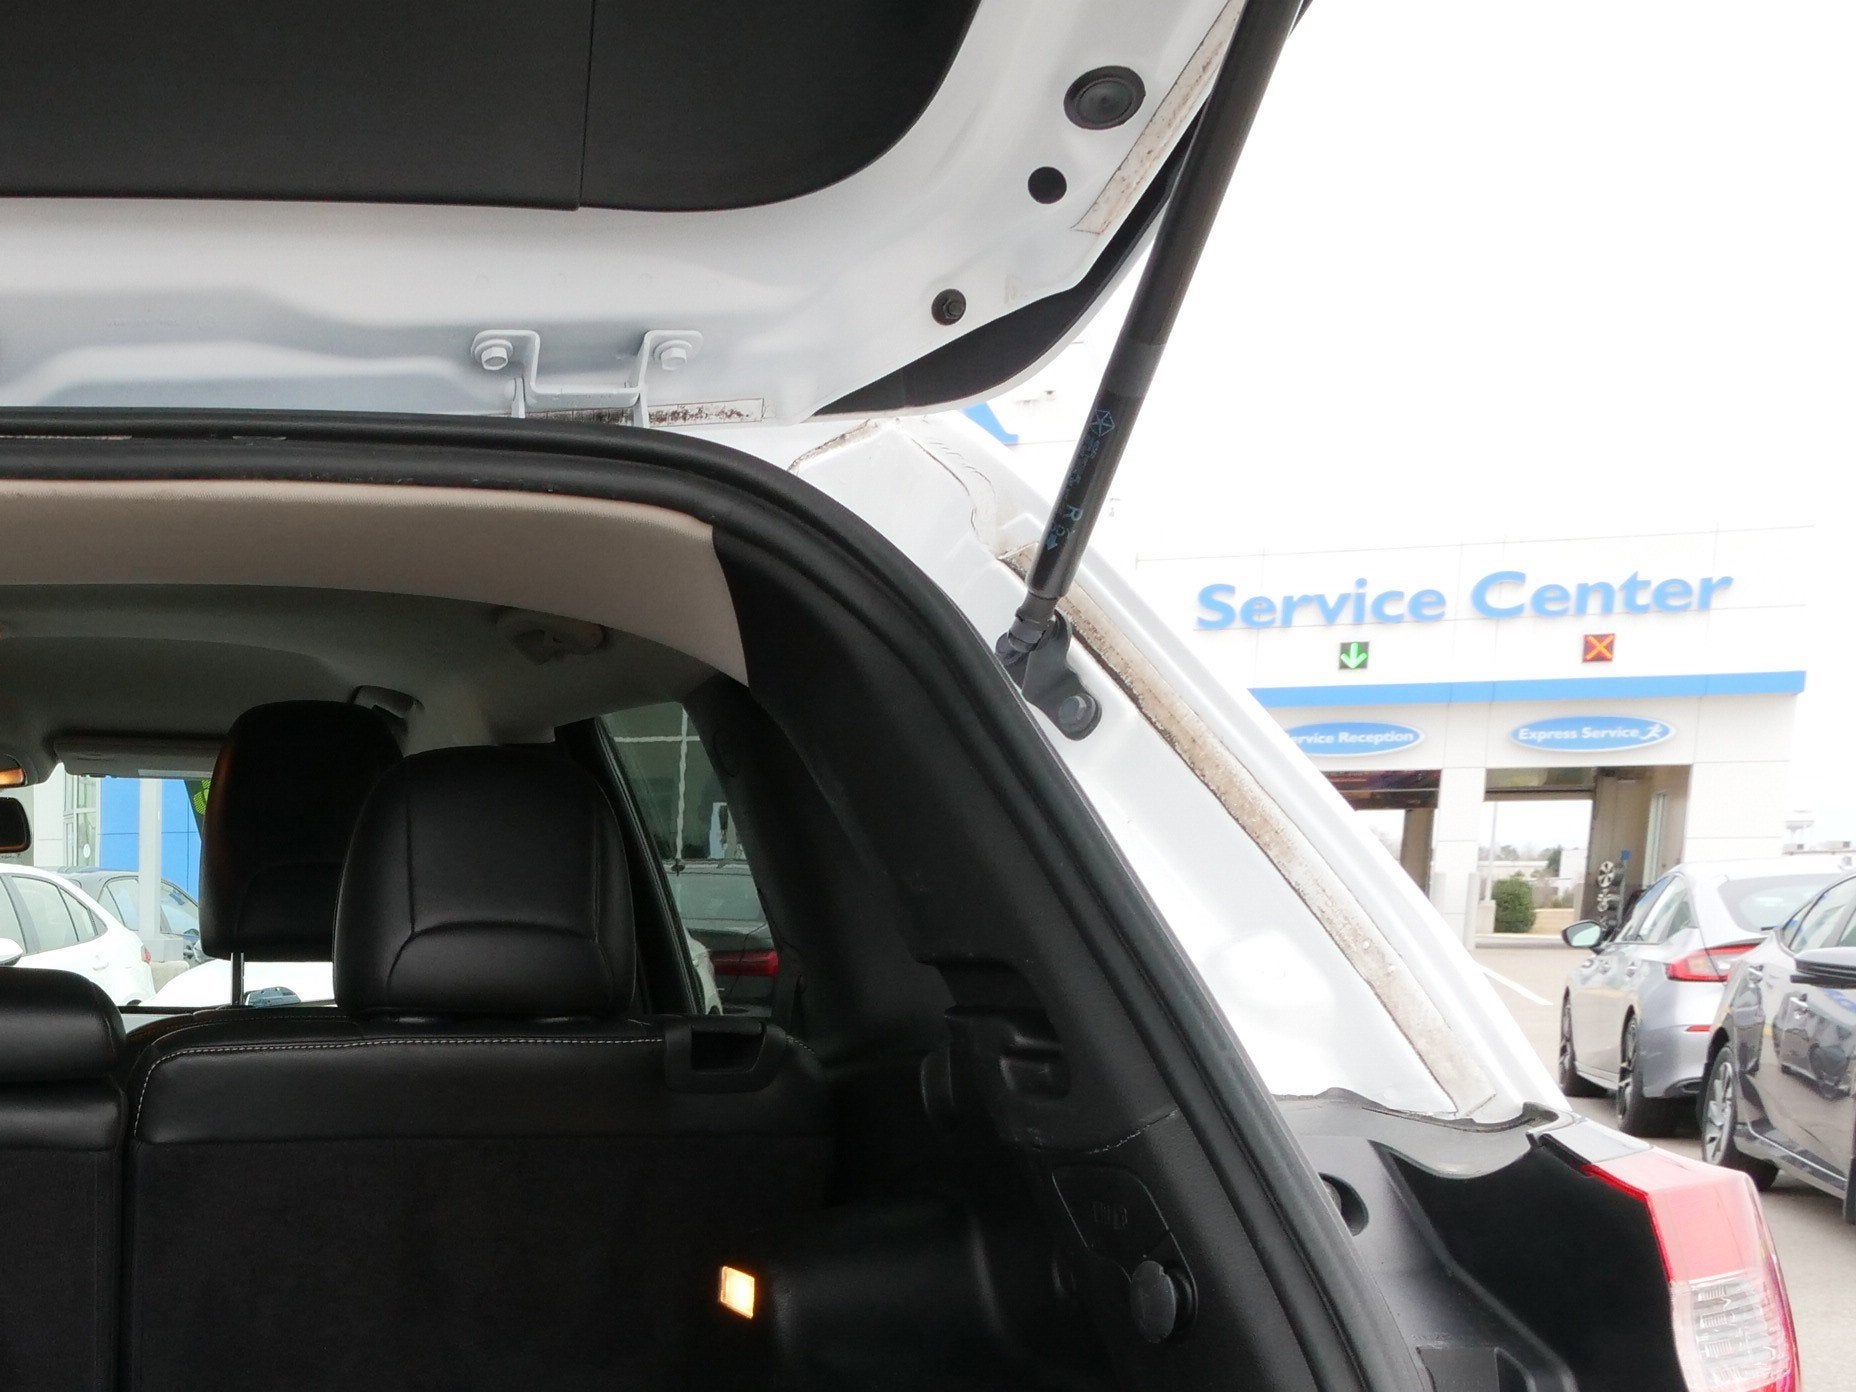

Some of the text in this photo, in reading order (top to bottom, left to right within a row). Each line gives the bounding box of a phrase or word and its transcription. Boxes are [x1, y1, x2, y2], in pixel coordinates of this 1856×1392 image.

[1196, 571, 1734, 631] Service Center
[1289, 730, 1415, 746] ervice Reception
[1517, 726, 1640, 743] Express Service
